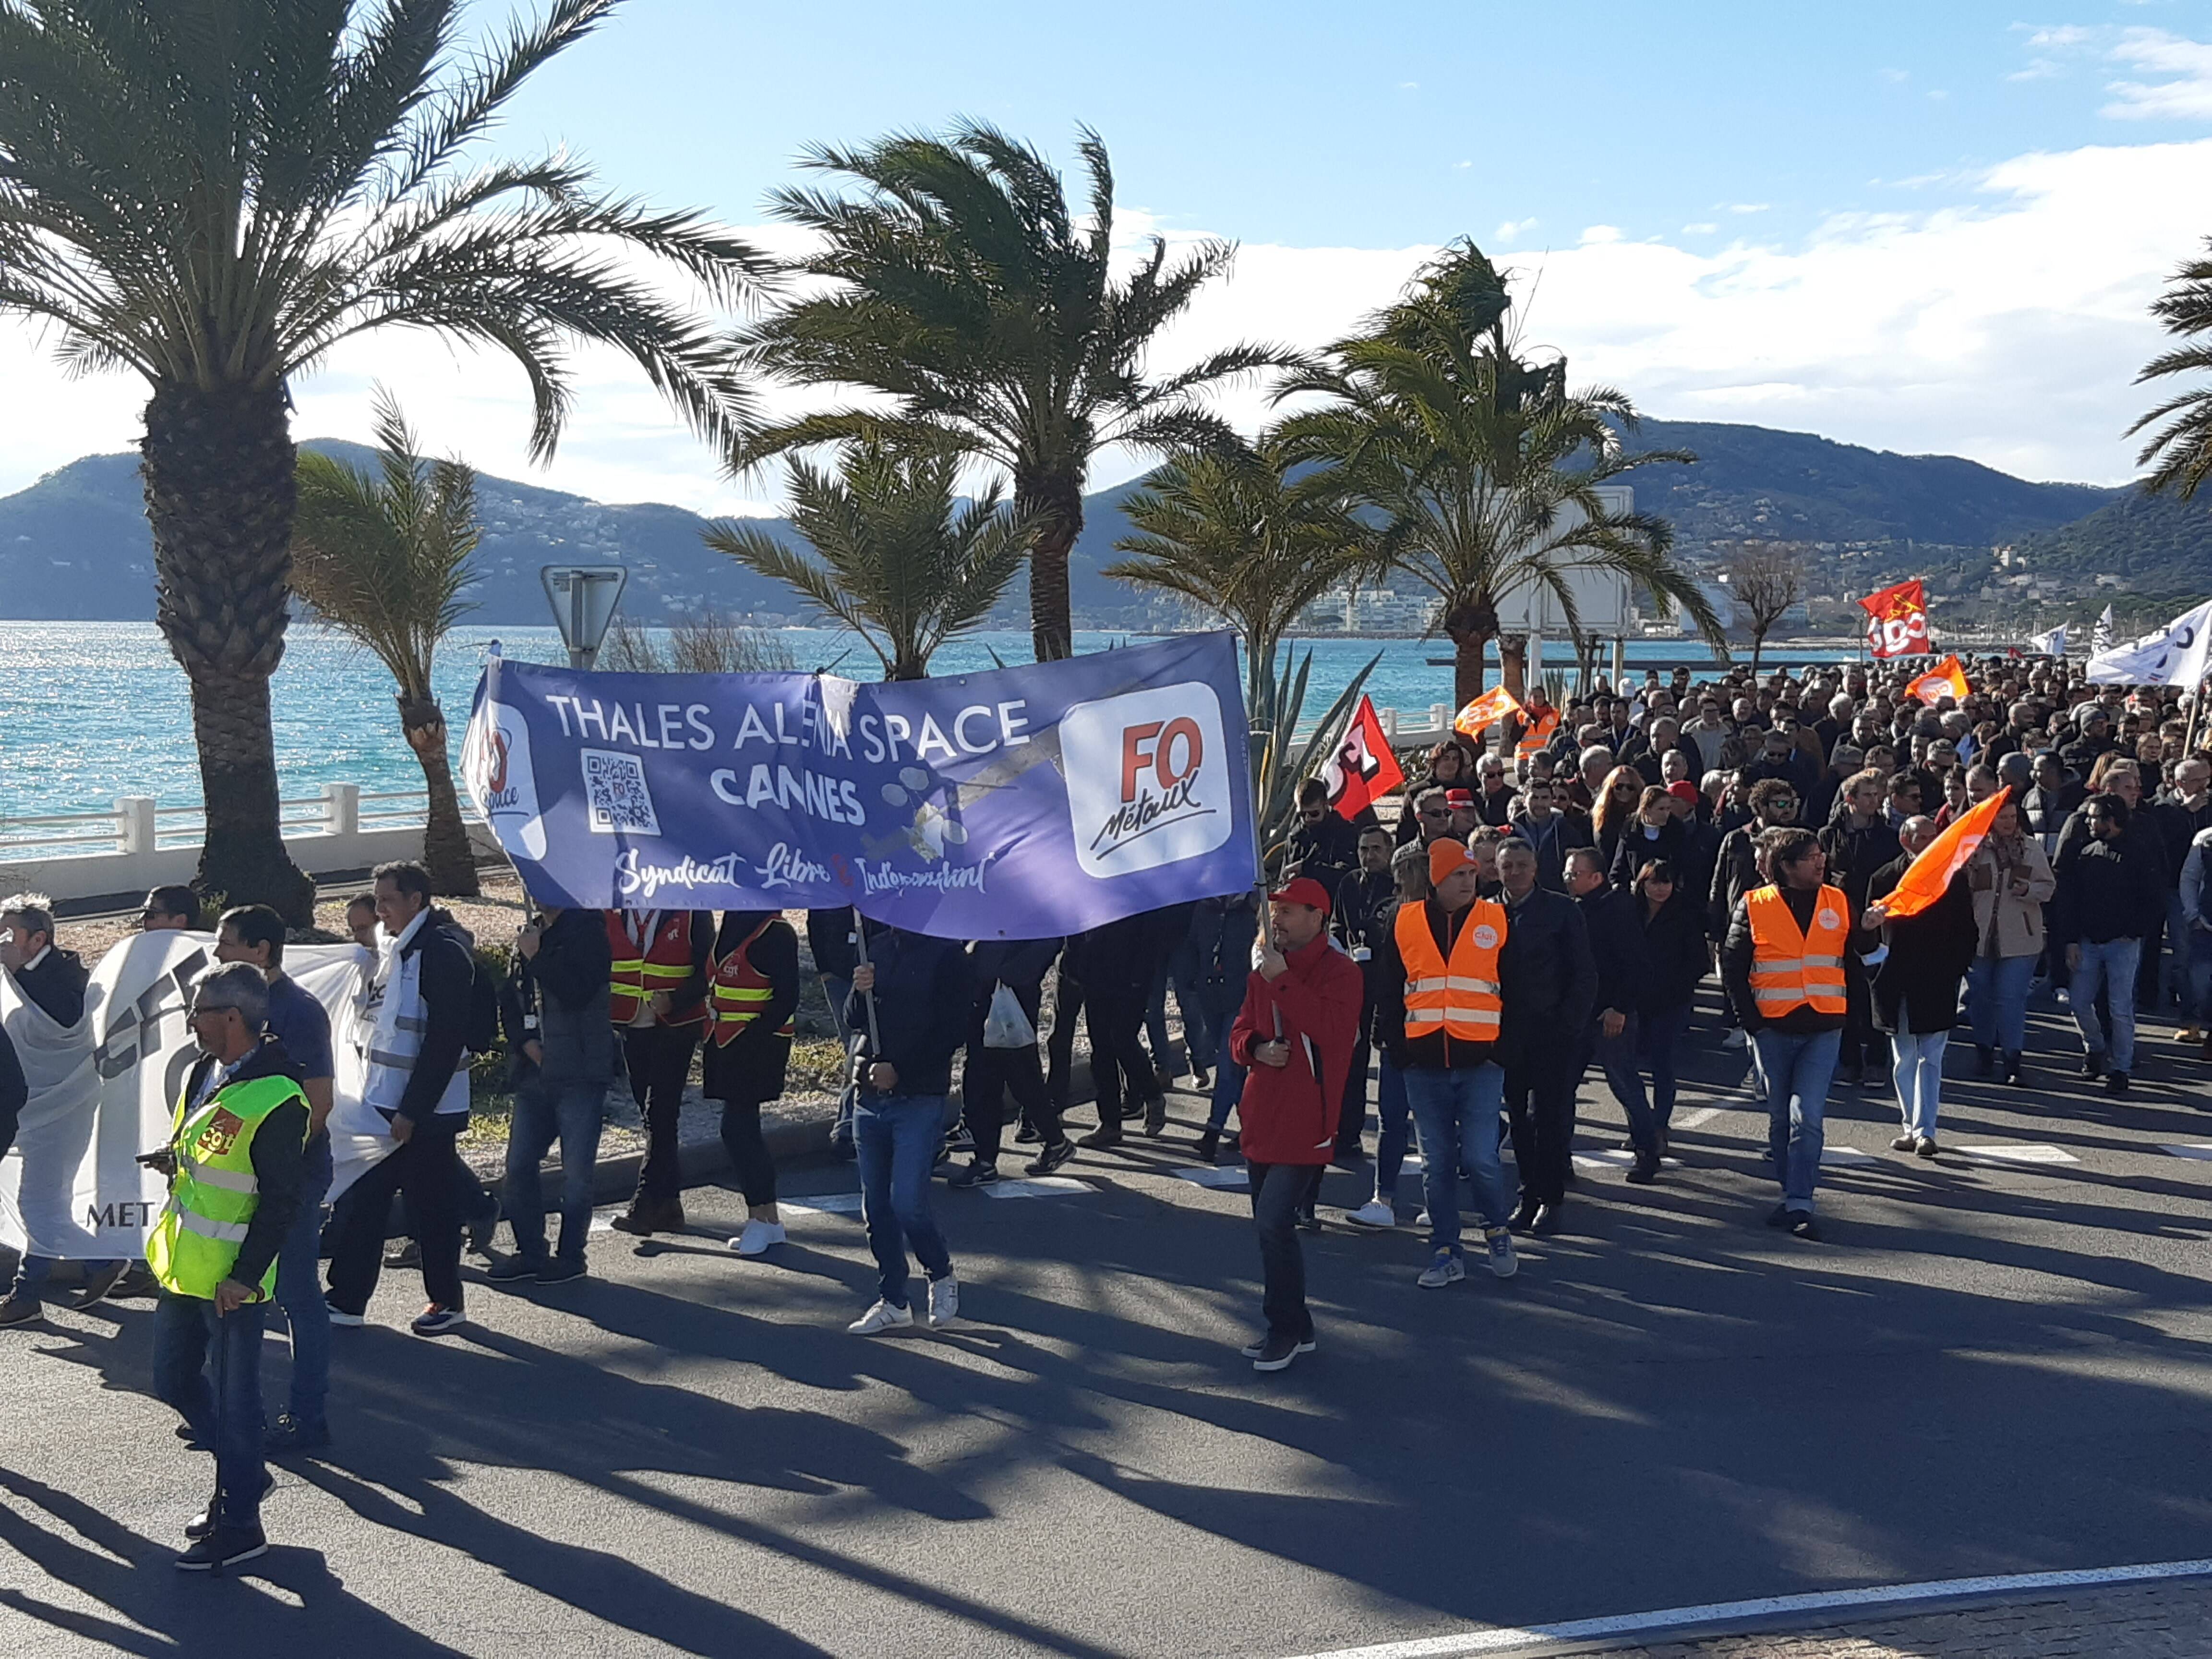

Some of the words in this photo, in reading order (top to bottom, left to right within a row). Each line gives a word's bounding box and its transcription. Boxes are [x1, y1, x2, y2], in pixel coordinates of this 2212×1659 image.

[545, 695, 715, 751] THALES
[733, 699, 853, 760] ALENIA
[859, 699, 1031, 763] SPACE
[1121, 716, 1203, 804] FO
[710, 764, 866, 826] CANNES
[1089, 769, 1202, 851] Métaux
[616, 848, 747, 898] Syndicat
[755, 842, 831, 889] Libre
[201, 1127, 235, 1152] cgt
[86, 1202, 157, 1228] MET
